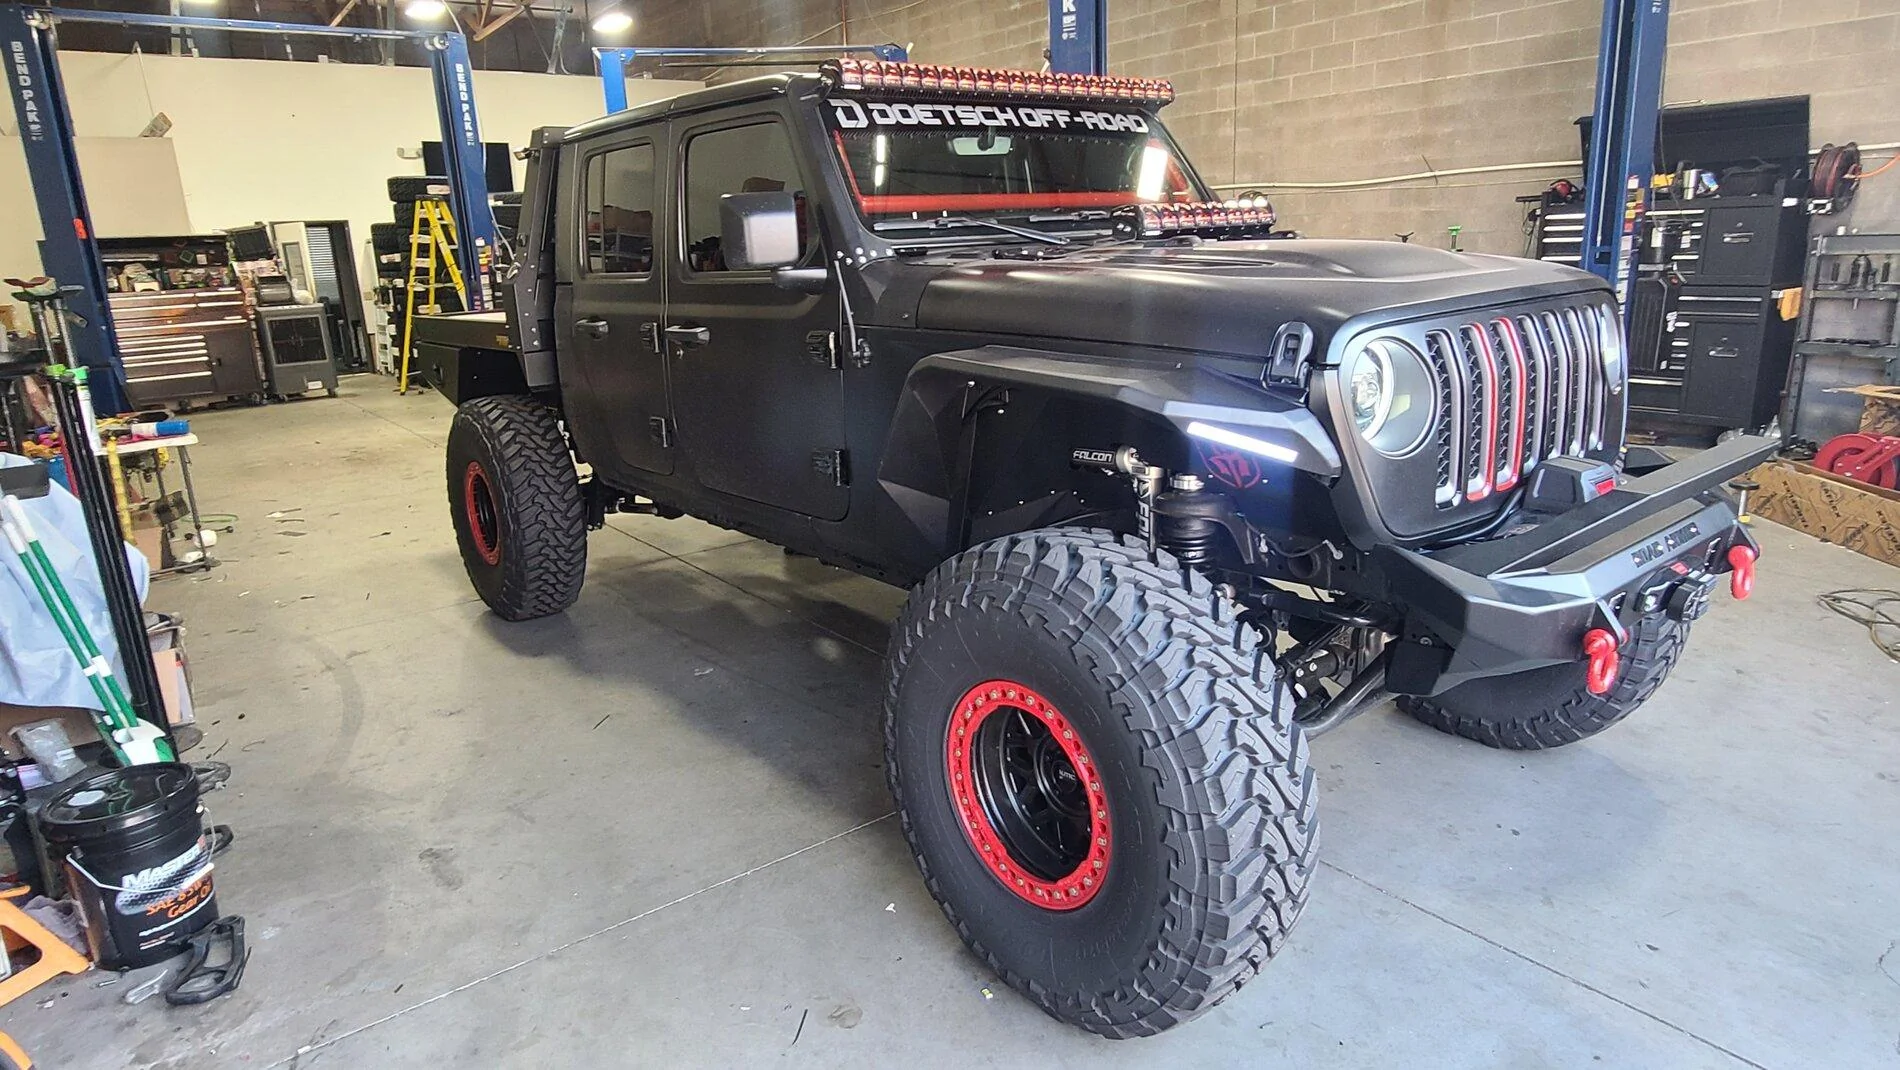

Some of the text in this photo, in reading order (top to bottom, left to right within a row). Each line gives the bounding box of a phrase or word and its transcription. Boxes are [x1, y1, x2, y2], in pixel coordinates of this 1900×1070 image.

[869, 103, 1021, 127] DOETSCH
[1020, 108, 1150, 133] OFF-ROAD
[1072, 450, 1113, 462] FALCON
[167, 895, 199, 918] Gear
